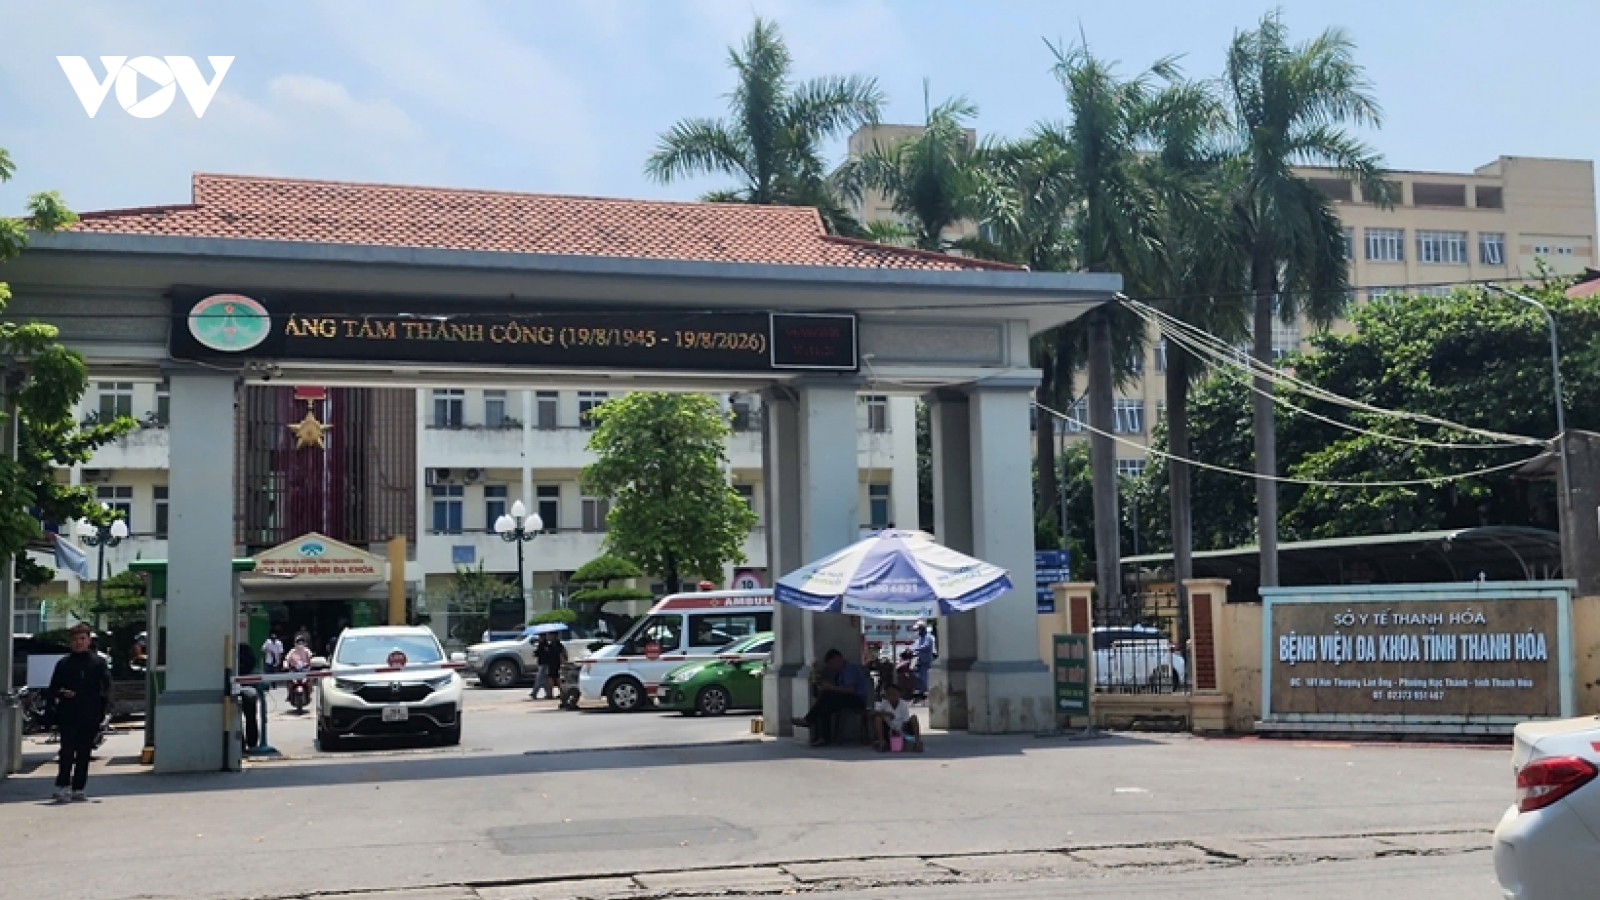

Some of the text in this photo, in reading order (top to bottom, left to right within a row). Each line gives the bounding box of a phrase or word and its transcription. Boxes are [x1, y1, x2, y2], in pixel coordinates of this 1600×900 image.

[489, 320, 554, 344] CÔNG
[559, 327, 657, 349] (19/8/1945
[675, 330, 766, 354] 19/8/2026)
[741, 580, 754, 590] 10
[725, 596, 773, 606] AMBUL
[1334, 607, 1486, 626] SỞ Y TẾ THANH HÓA
[1279, 627, 1548, 666] BỆNH VIỆN ĐA KHOA TỈNH THANH HÓA
